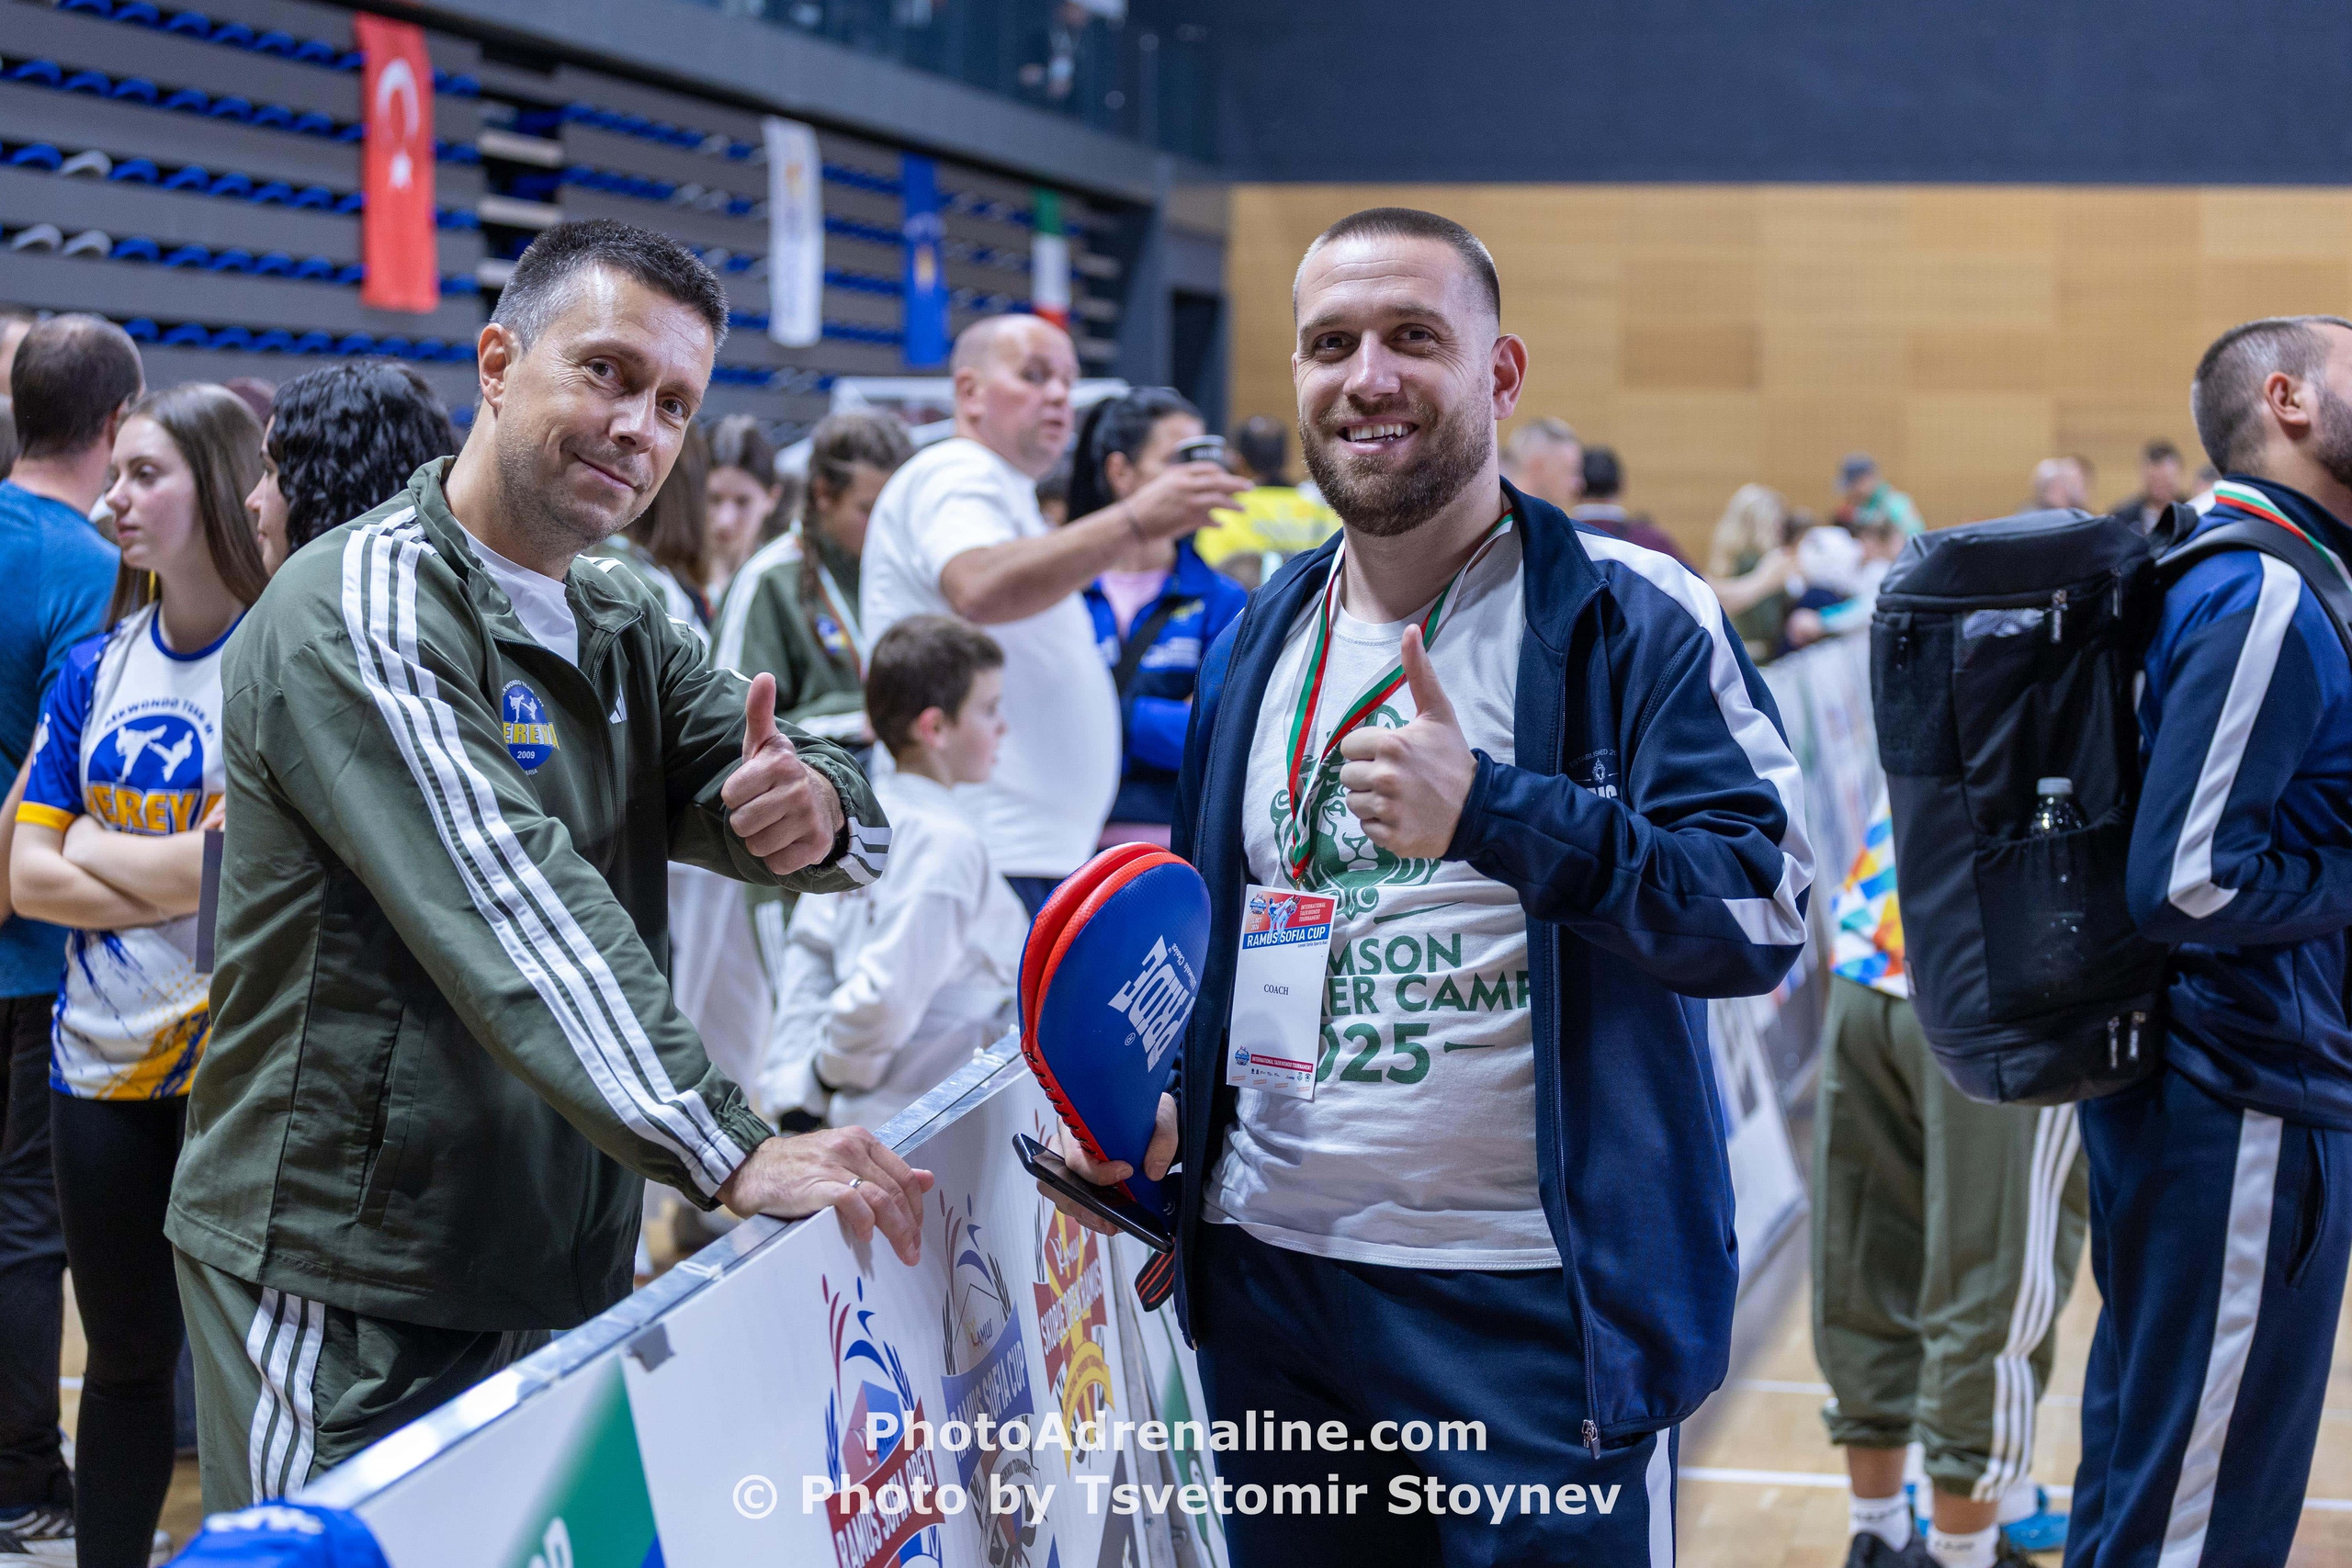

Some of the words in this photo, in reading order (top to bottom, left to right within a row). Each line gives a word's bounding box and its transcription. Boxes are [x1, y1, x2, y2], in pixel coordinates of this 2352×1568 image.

[517, 750, 536, 759] 2009
[1247, 931, 1278, 947] RAMUS
[1280, 928, 1305, 943] SOFIA
[1307, 926, 1326, 940] CUP
[1107, 935, 1196, 1073] PRIDE
[1263, 984, 1289, 995] COACH
[1321, 976, 1380, 1016] ER
[1040, 1297, 1067, 1356] SKOPJE
[1063, 1280, 1082, 1330] OPEN
[982, 1359, 1012, 1424] SOFIA
[1006, 1340, 1026, 1397] CUP
